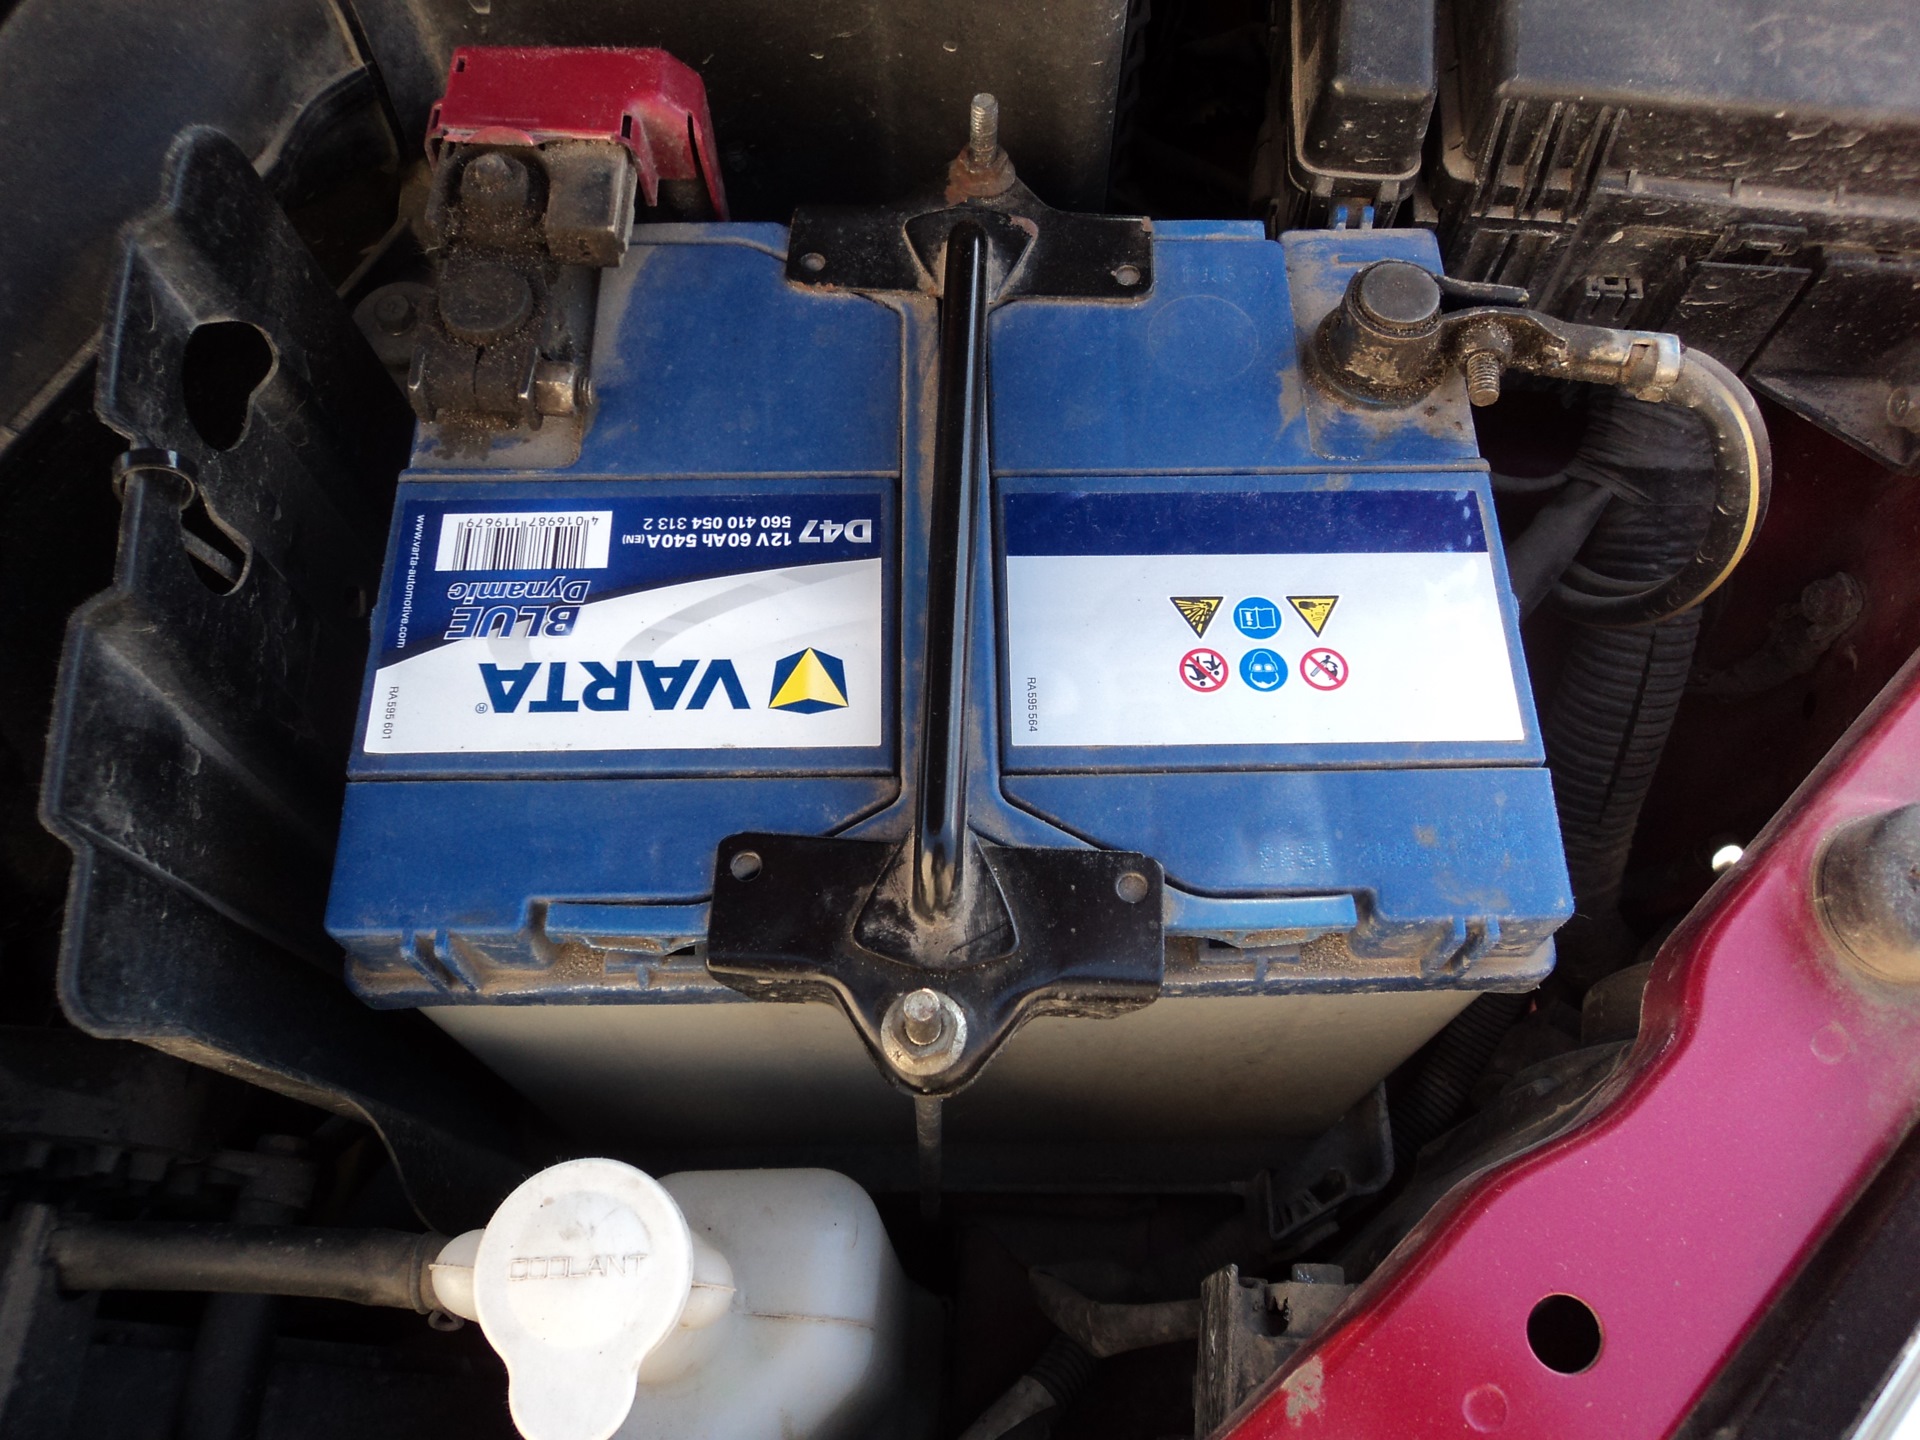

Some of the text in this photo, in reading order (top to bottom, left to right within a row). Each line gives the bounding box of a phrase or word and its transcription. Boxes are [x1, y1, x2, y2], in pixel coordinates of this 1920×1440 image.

[466, 516, 599, 528] 4 016987 119679
[643, 516, 792, 530] 560 410 054 313 2
[799, 519, 872, 543] D47
[703, 532, 751, 548] 60Ah
[756, 531, 792, 547] 12V
[396, 514, 425, 648] www.varta-automotive.com
[447, 576, 591, 605] Dynamic
[443, 604, 581, 640] BLUE
[382, 722, 393, 740] 601
[1028, 713, 1038, 732] 564
[508, 1253, 648, 1281] COOLANT
